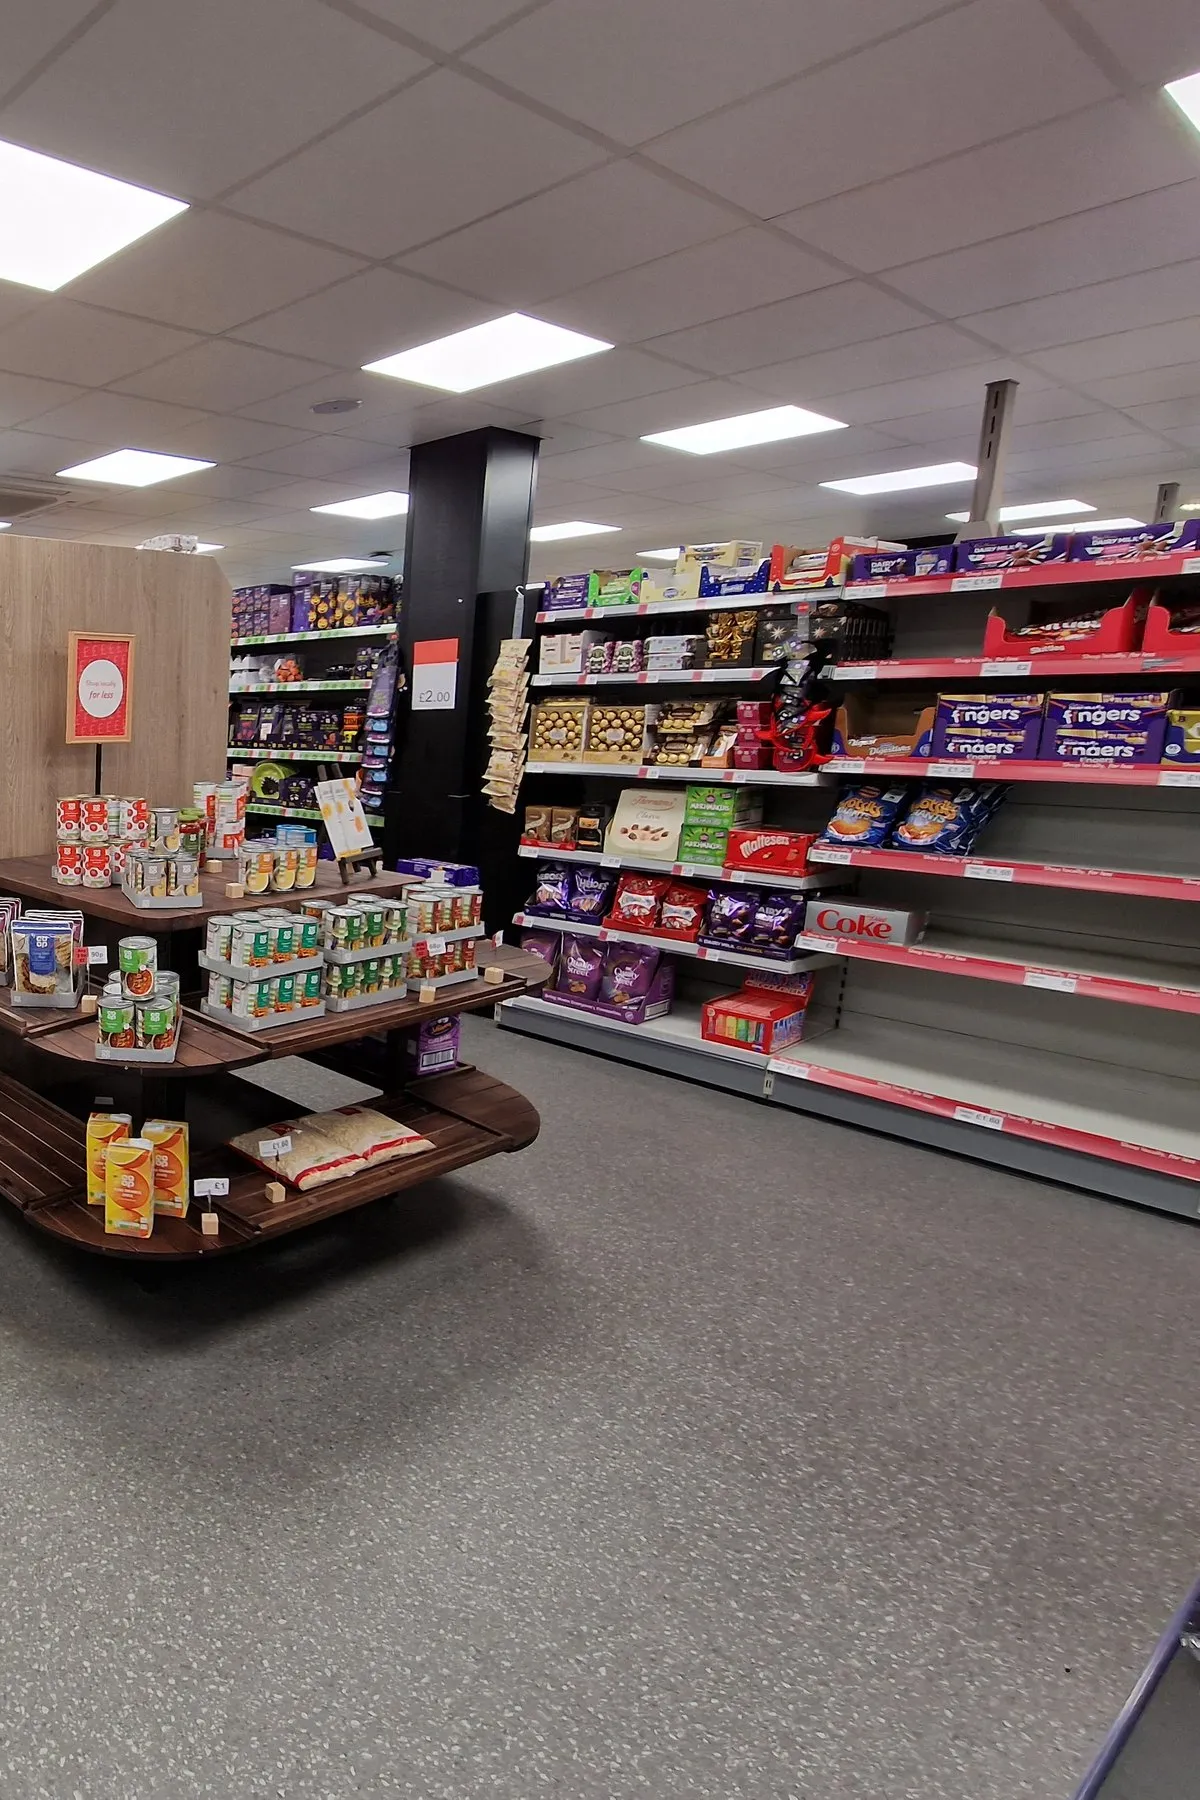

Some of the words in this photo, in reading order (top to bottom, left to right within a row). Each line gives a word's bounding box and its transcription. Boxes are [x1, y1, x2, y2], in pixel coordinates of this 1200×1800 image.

[871, 560, 896, 568] DAIRY
[89, 690, 100, 700] for
[101, 690, 114, 699] less
[419, 690, 450, 703] £2.00
[951, 708, 1021, 725] fingers
[1062, 709, 1142, 726] fingers
[739, 835, 790, 859] Maltesers
[816, 910, 893, 939] Coke
[272, 1140, 289, 1150] £1.60
